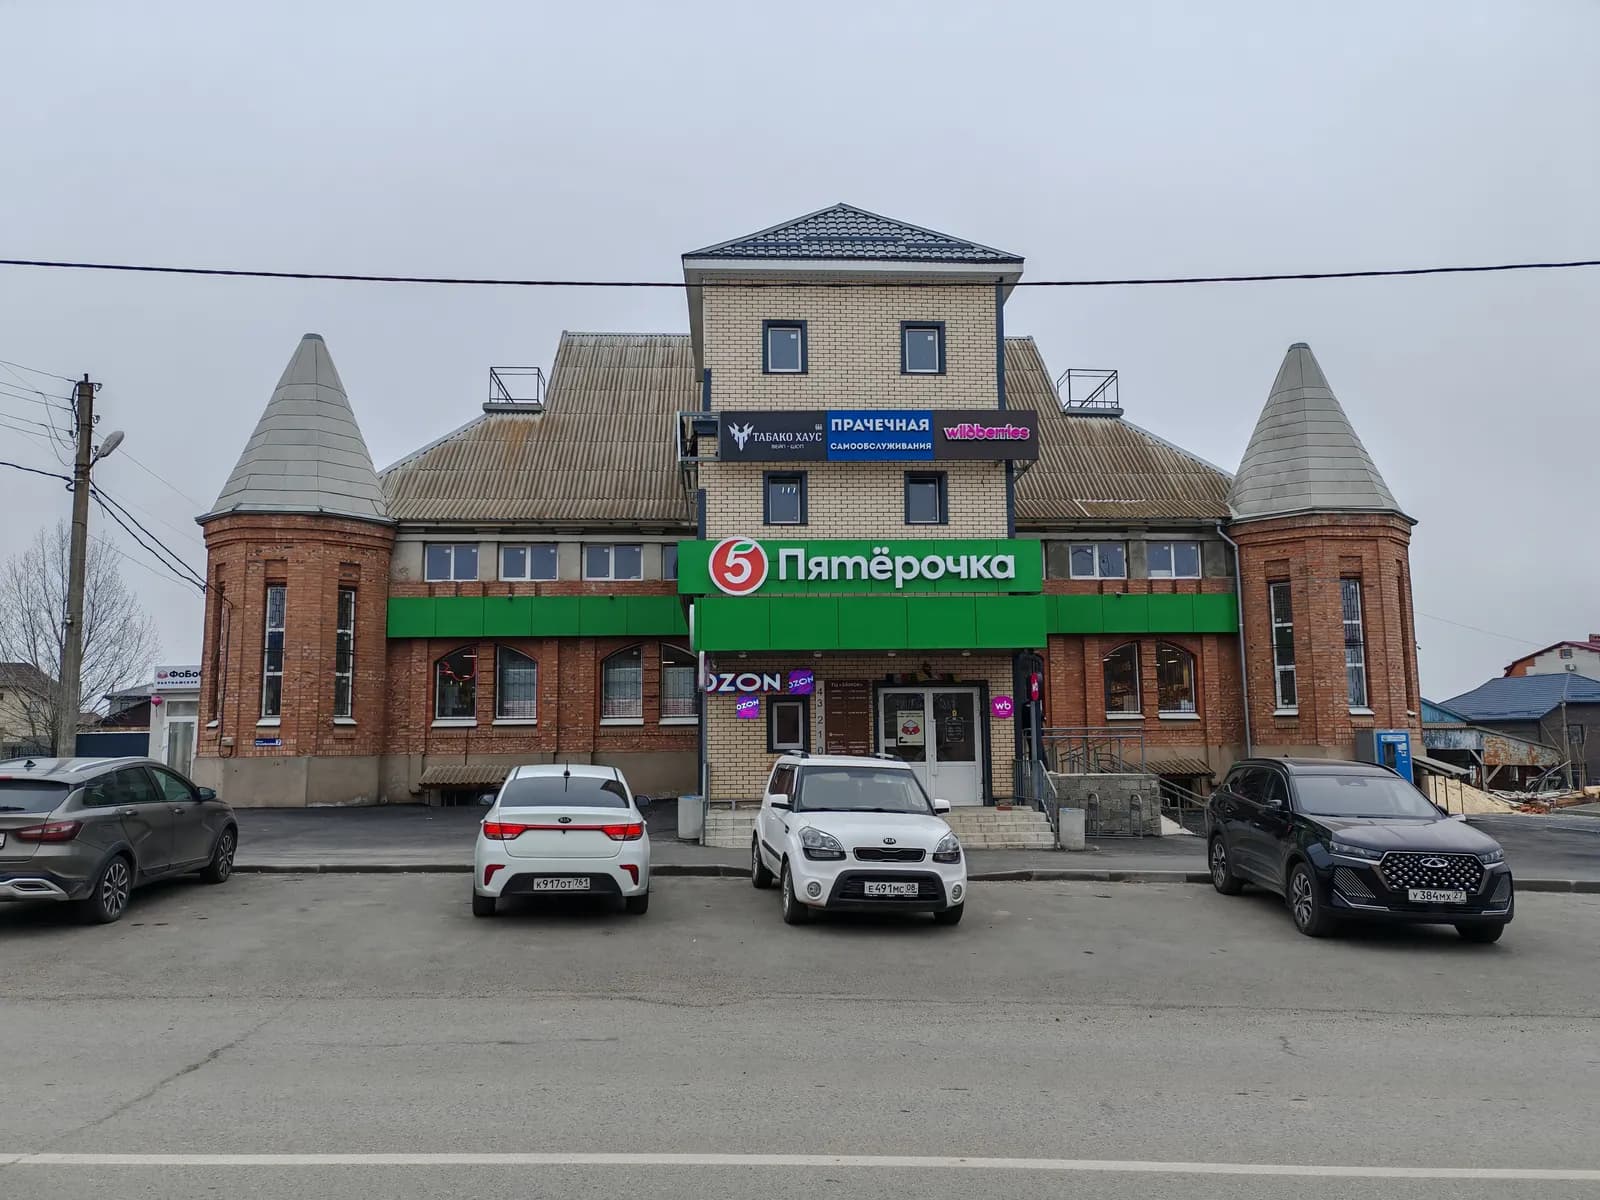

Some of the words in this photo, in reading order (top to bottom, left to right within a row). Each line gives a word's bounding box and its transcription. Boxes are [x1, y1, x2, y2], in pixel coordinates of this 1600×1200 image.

[831, 419, 929, 432] ПРАЧЕЧНАЯ
[943, 423, 1030, 440] wildberries
[752, 432, 793, 442] ТАБАКО
[795, 432, 822, 442] ХАУС
[830, 442, 932, 450] САМООБСЛУЖИВАНИЯ
[778, 546, 1015, 589] Пятёрочка
[817, 698, 823, 707] 3
[995, 700, 1011, 710] wb
[817, 716, 823, 725] 2
